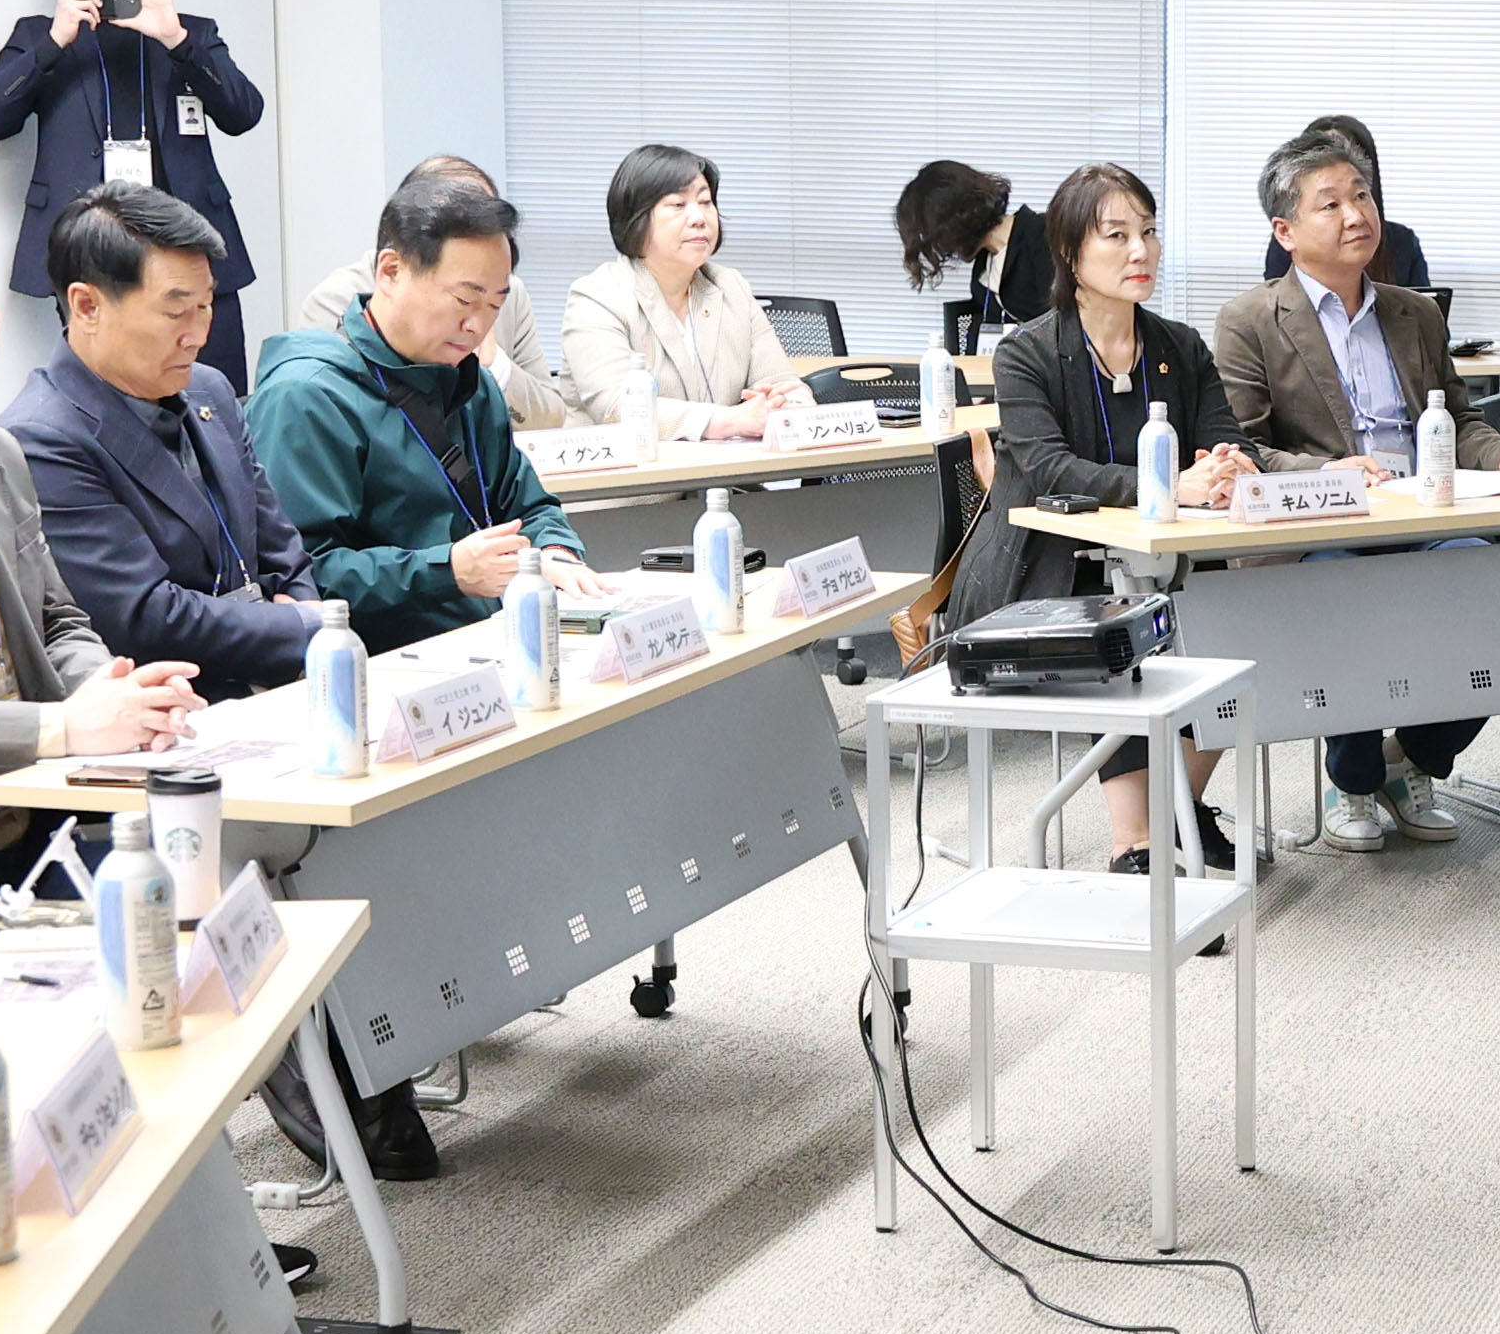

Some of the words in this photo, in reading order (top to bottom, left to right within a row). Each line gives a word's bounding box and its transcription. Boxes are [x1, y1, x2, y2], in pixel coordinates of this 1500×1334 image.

[834, 421, 875, 437] ヘリョン
[1282, 494, 1310, 512] キム
[1315, 491, 1357, 509] ソニム
[442, 711, 454, 736] イ
